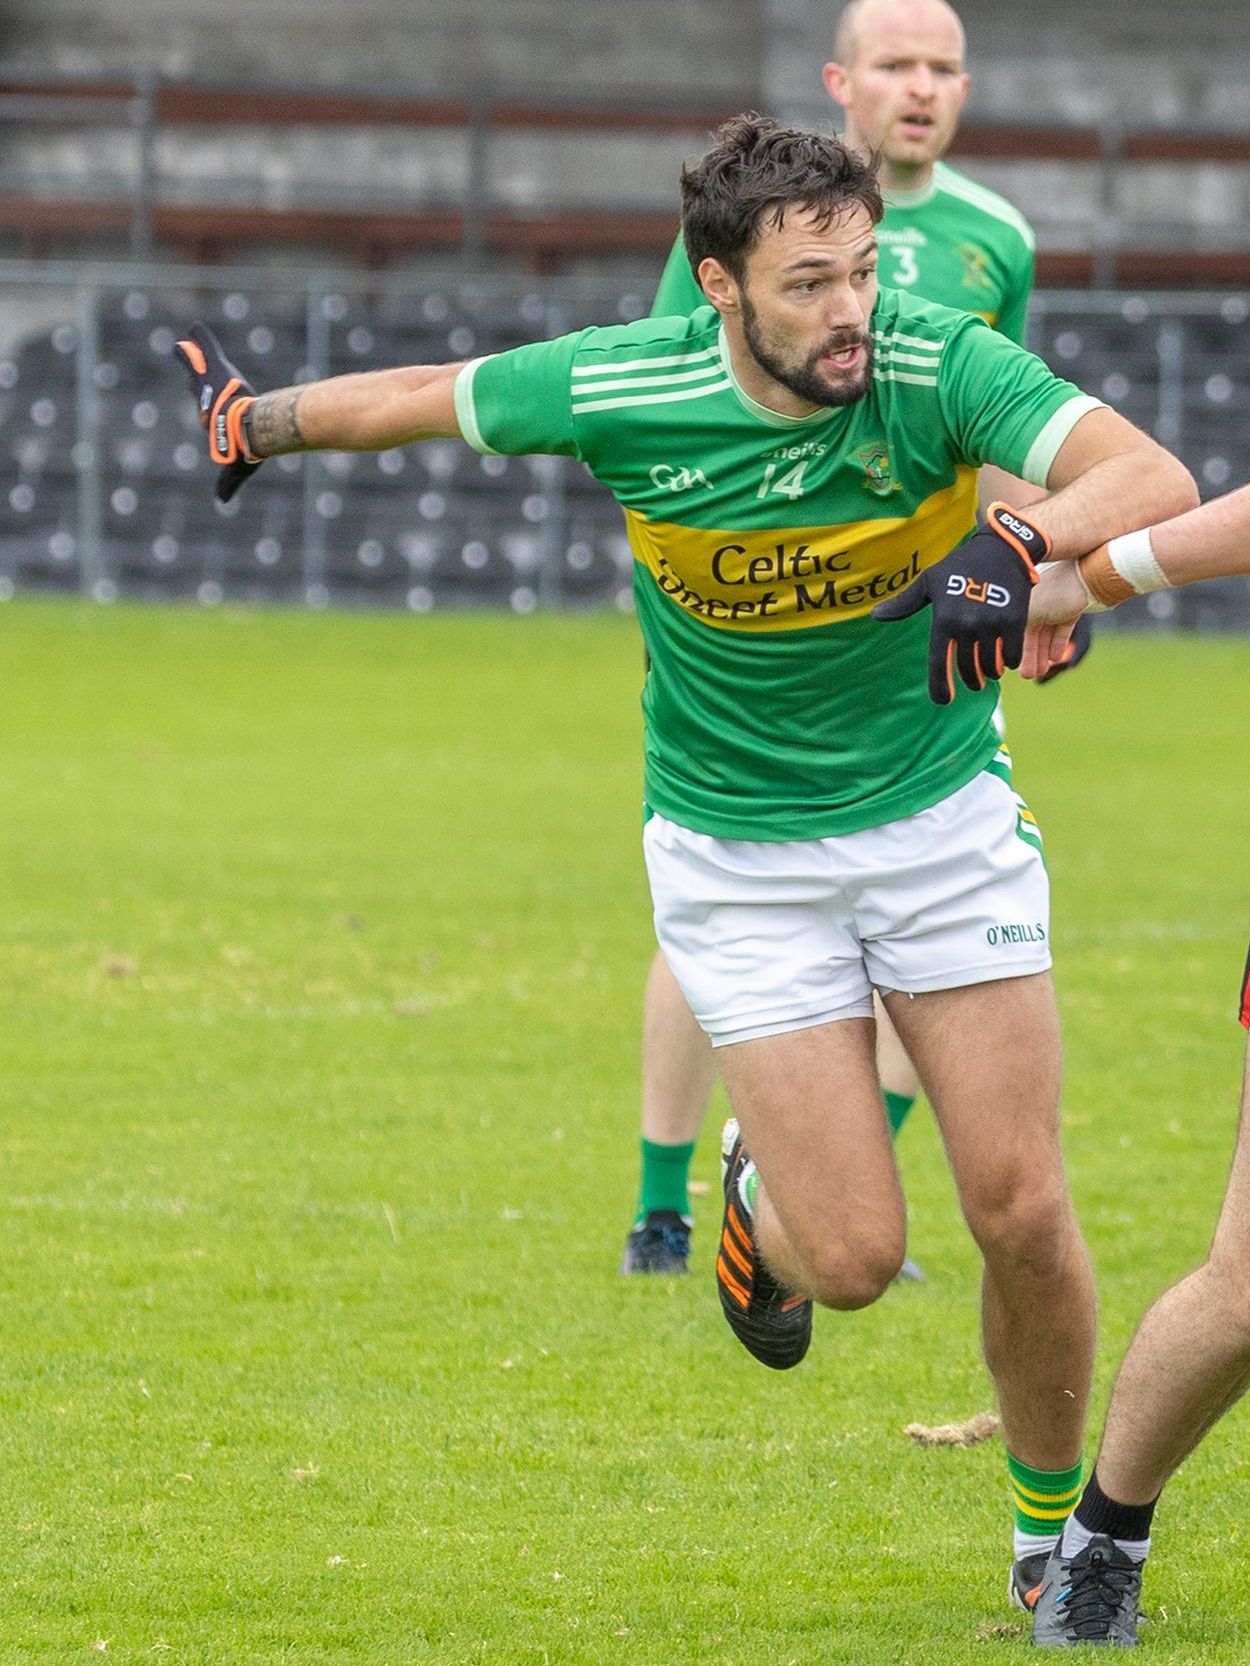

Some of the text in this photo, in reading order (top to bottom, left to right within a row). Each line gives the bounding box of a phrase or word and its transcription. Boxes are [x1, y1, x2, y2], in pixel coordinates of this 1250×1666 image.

[890, 246, 919, 285] 3
[756, 461, 809, 500] 14
[711, 544, 852, 586] Celtic
[794, 550, 922, 612] Metal
[946, 574, 1011, 607] GRG
[986, 923, 1046, 946] O'NEILLS
